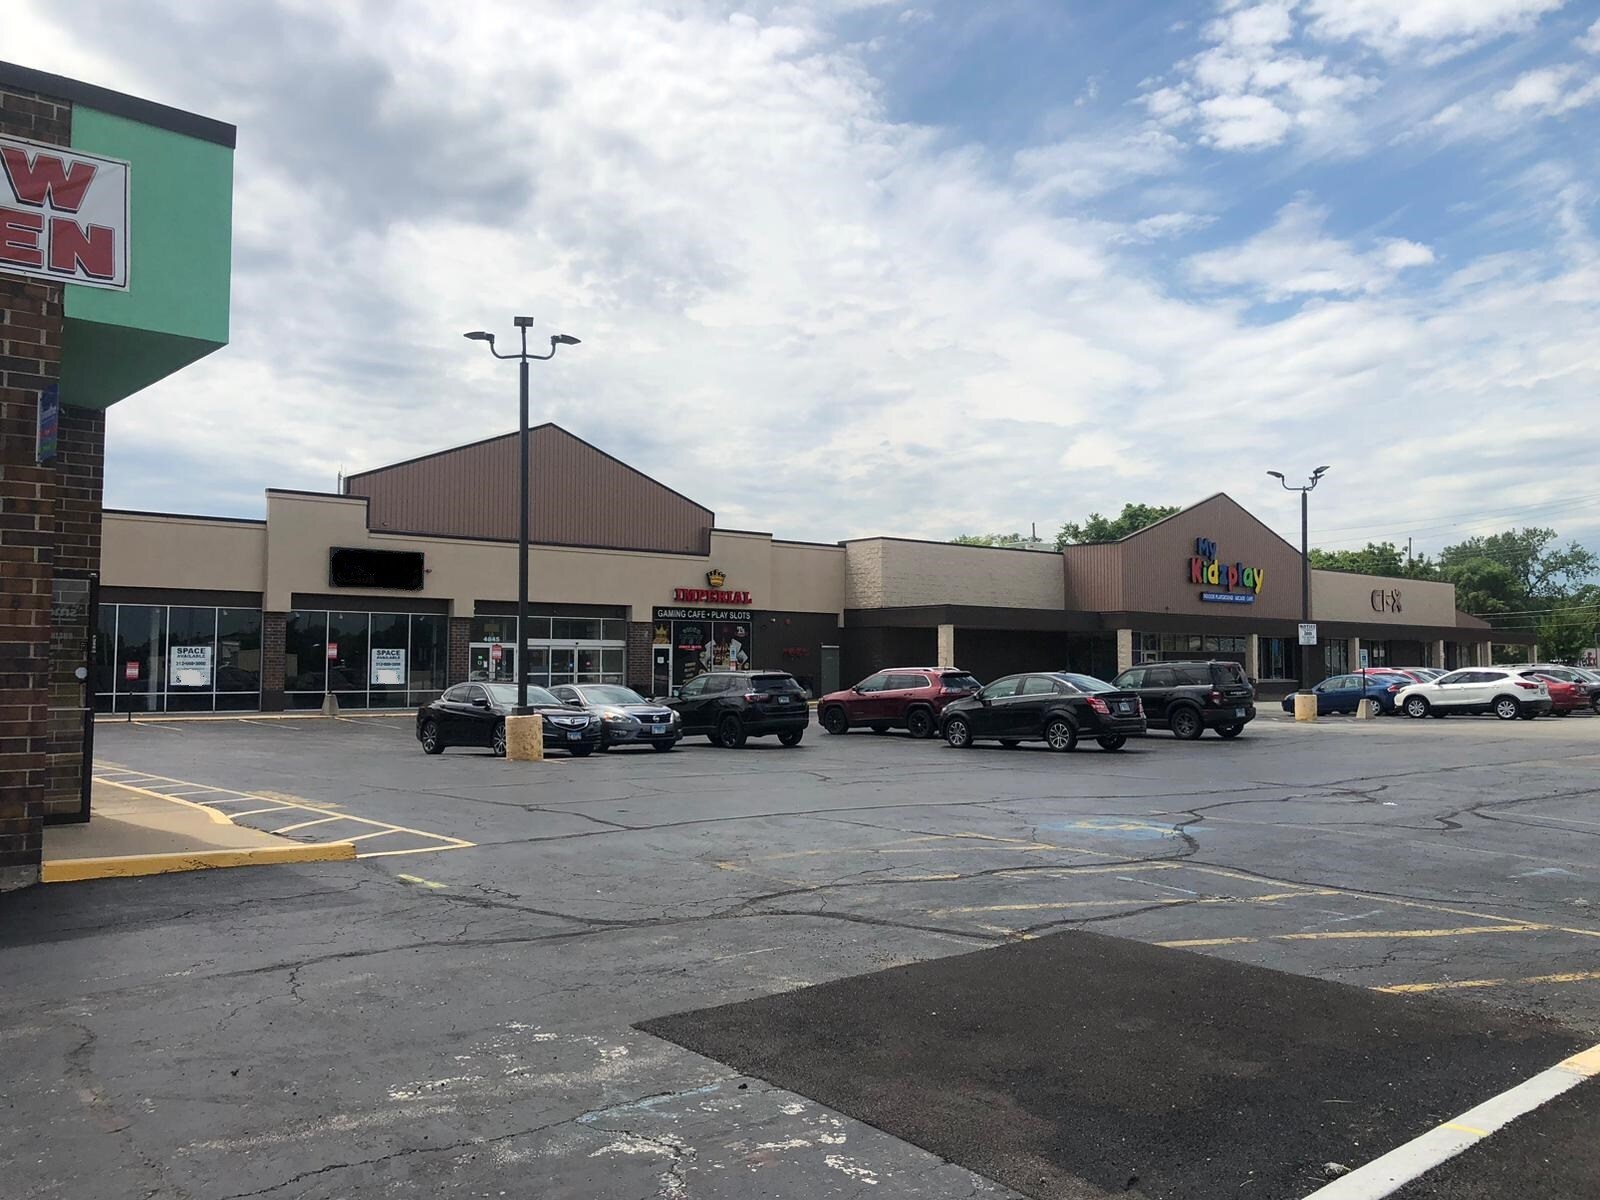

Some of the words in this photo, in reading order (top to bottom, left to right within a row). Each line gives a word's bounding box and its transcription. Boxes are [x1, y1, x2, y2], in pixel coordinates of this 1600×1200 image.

[1196, 537, 1217, 561] My
[1190, 557, 1264, 595] Kidzplay
[674, 588, 752, 604] IMPERIAL
[657, 609, 686, 618] GAMING
[687, 610, 706, 619] CAFE
[711, 611, 728, 619] PLAY
[729, 611, 751, 620] SLOTS
[176, 647, 206, 655] SPACE
